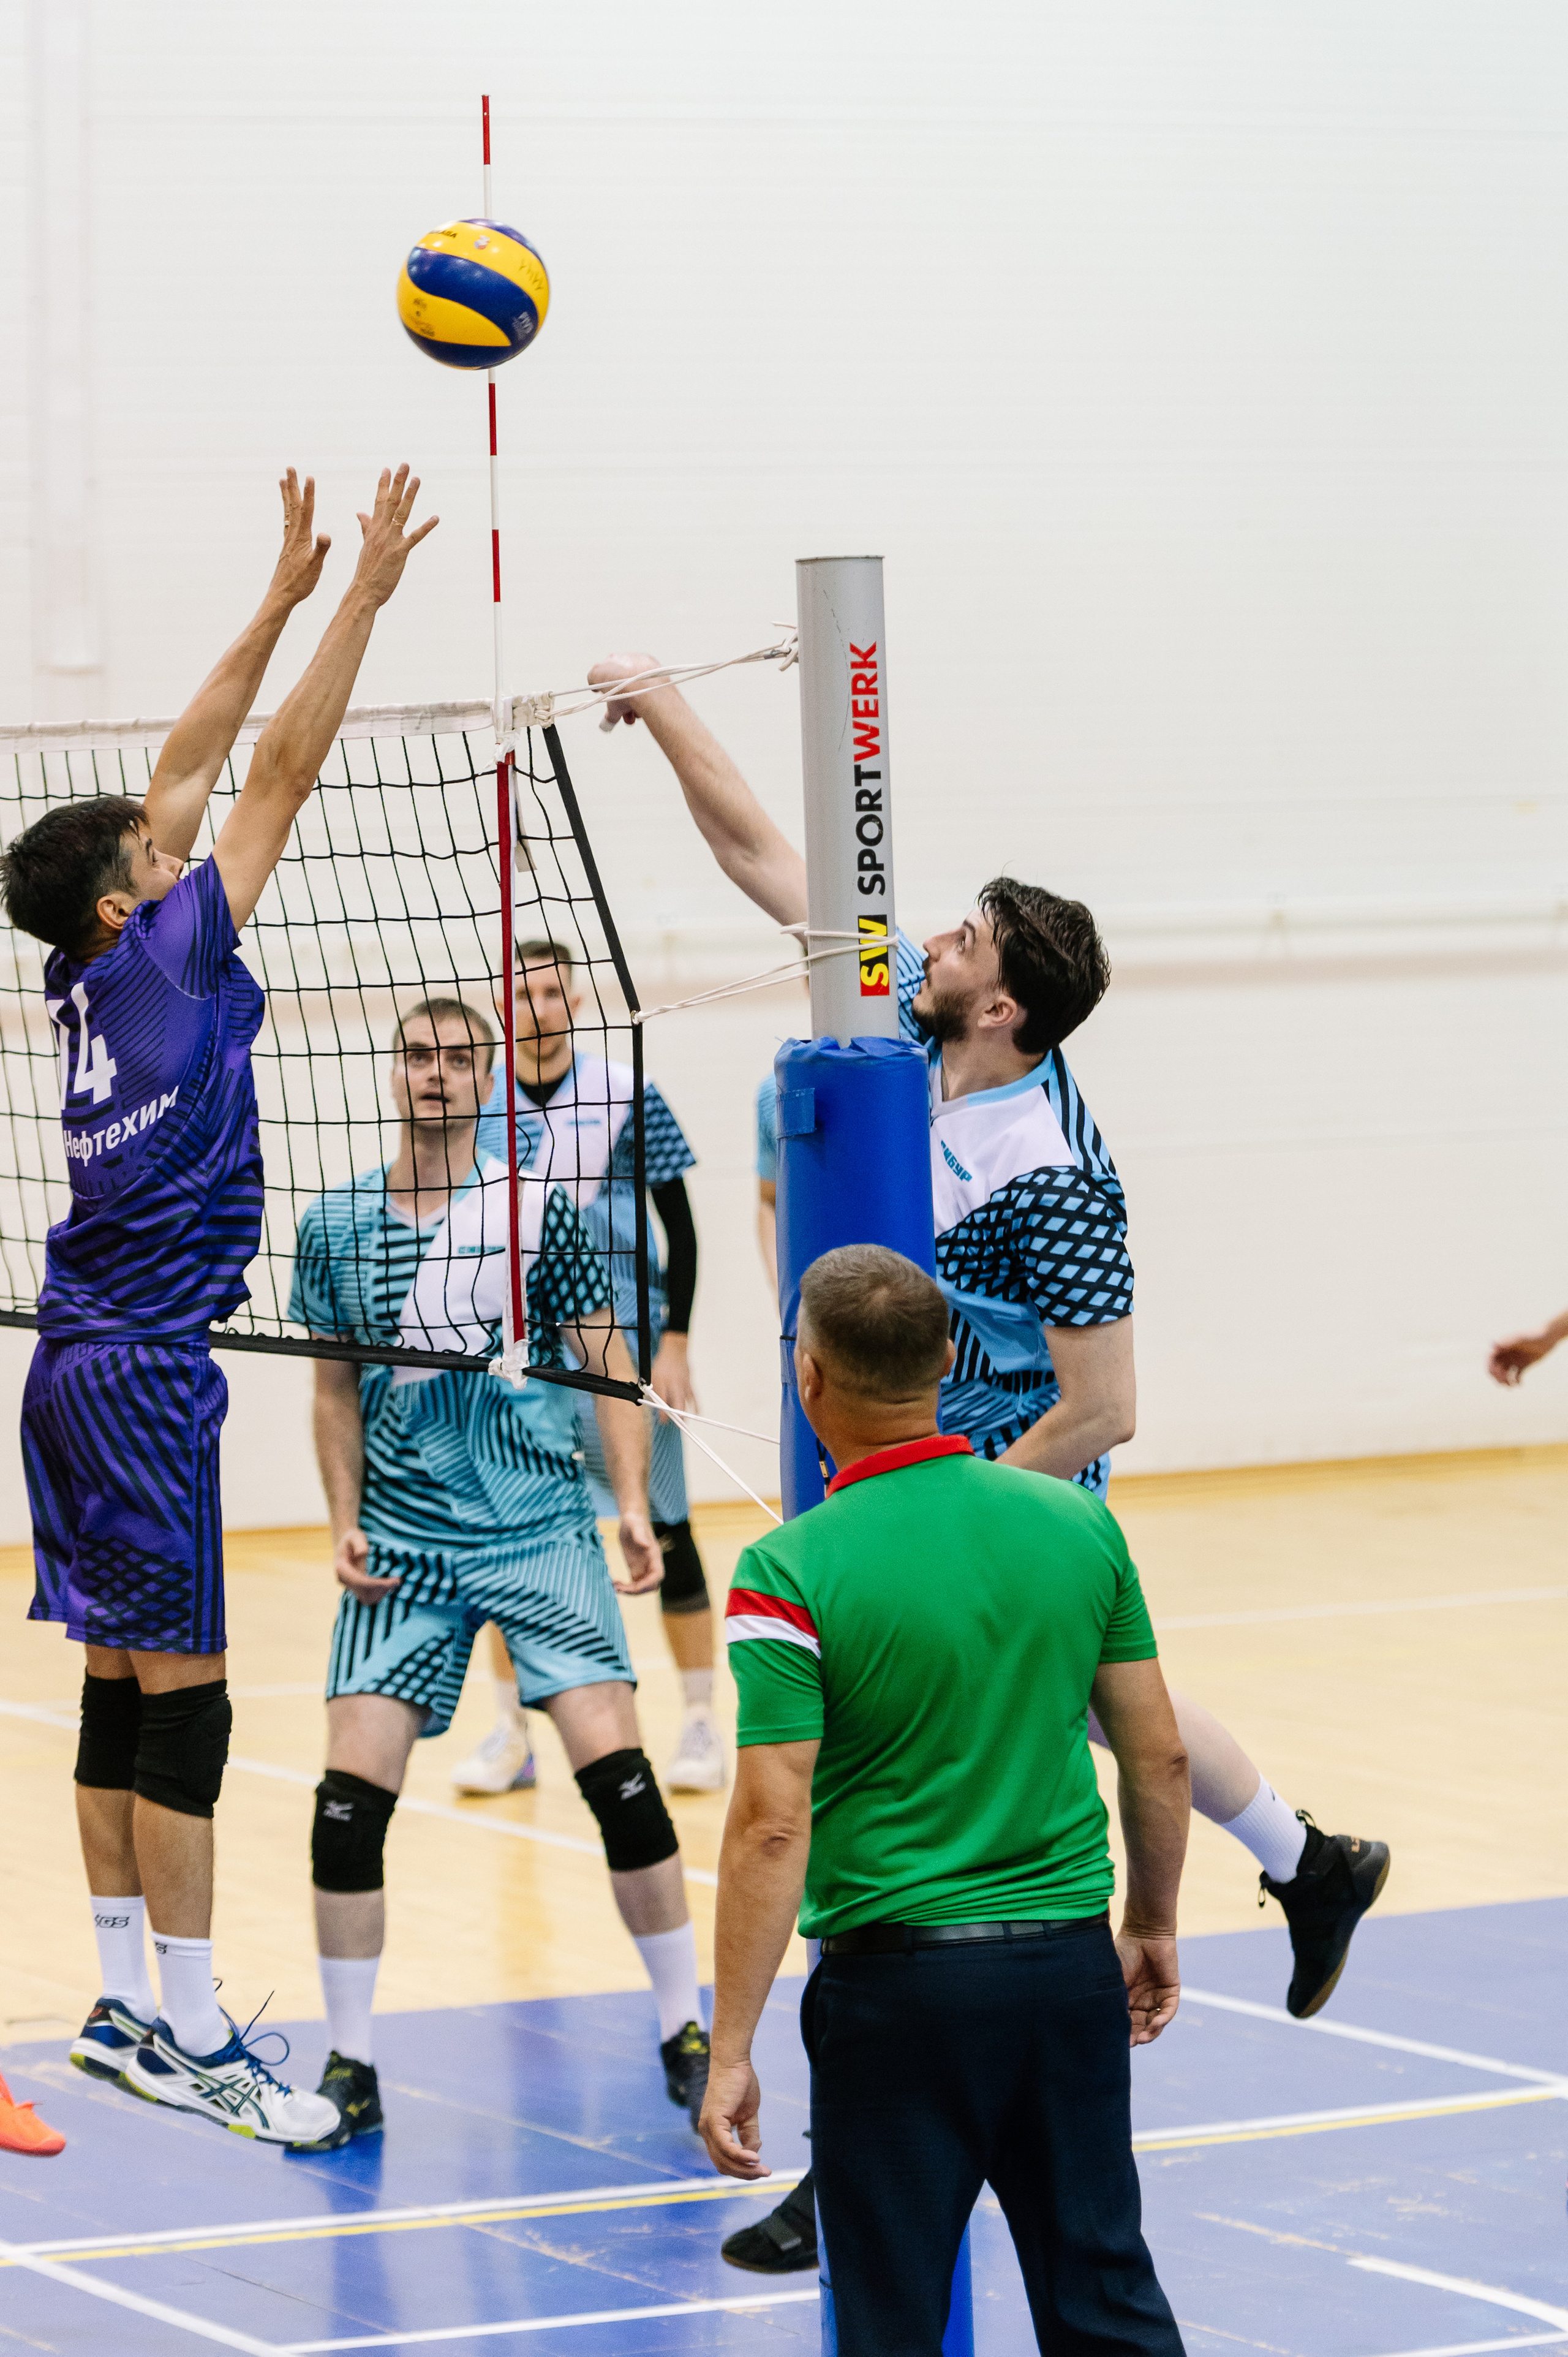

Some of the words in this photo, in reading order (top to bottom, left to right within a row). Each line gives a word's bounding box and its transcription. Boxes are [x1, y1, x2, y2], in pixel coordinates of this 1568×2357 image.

[849, 641, 886, 896] SPORTWERK
[859, 918, 889, 987] SW
[62, 1085, 179, 1167] Нефтехим
